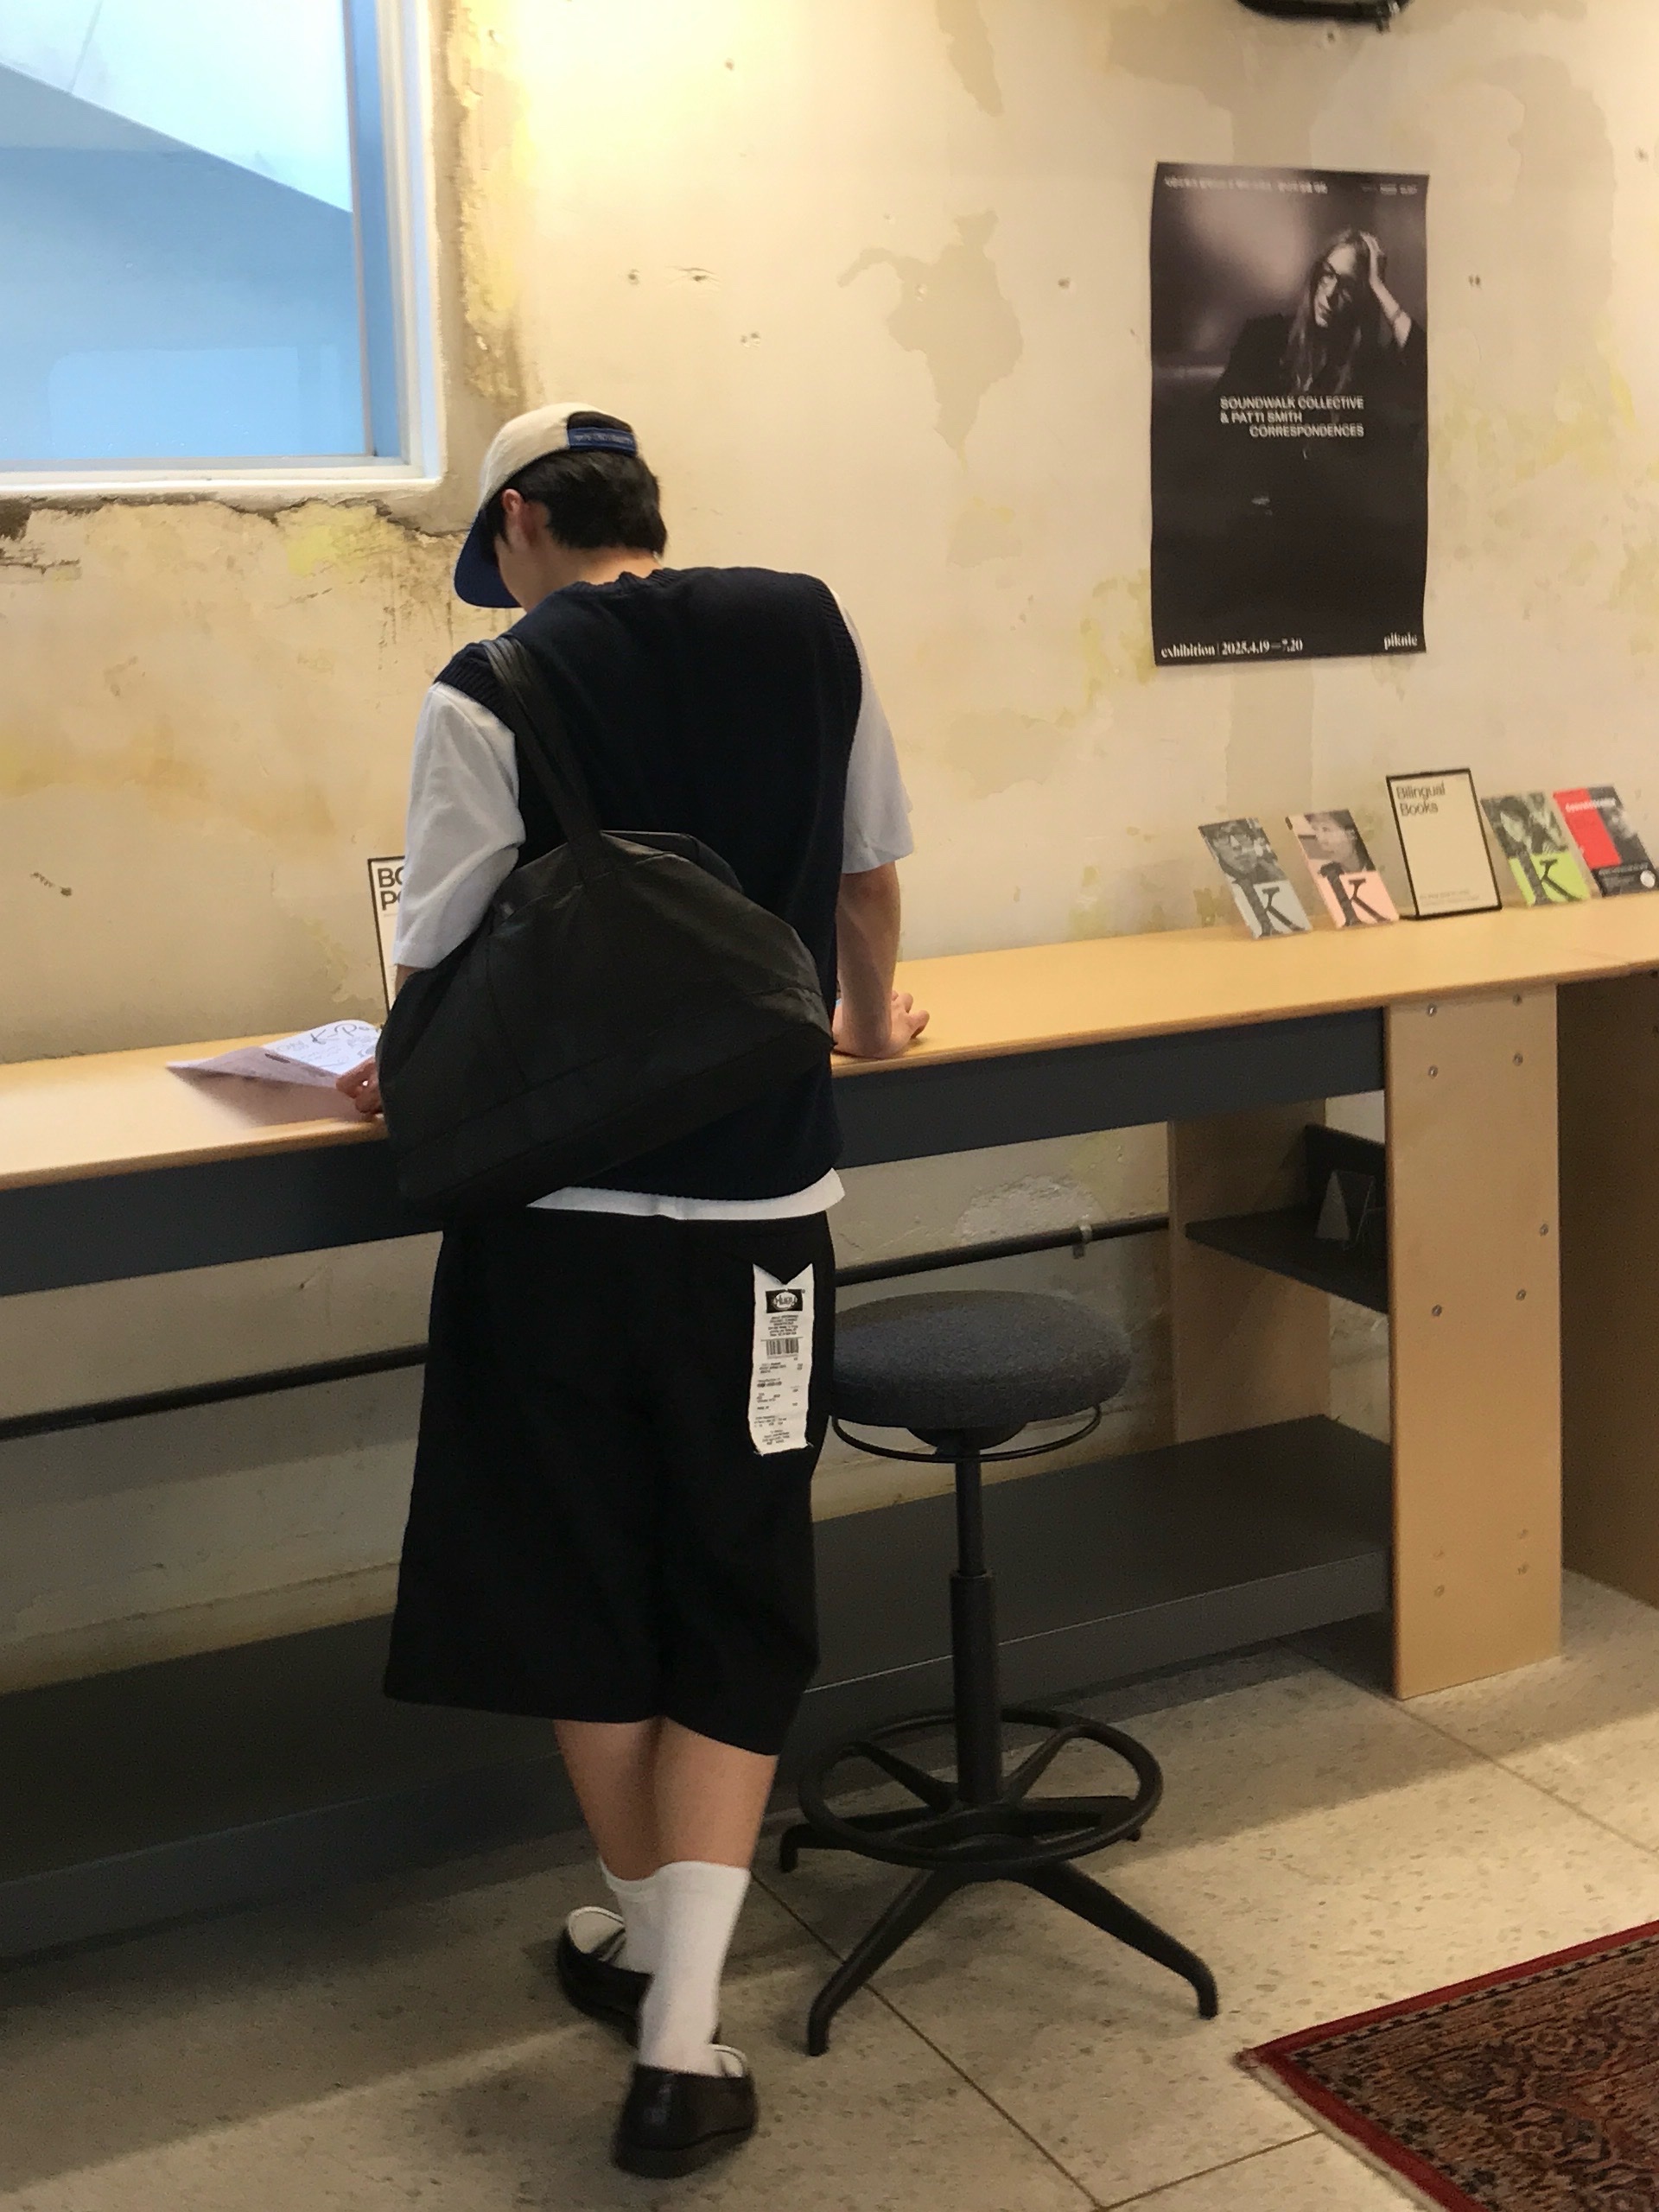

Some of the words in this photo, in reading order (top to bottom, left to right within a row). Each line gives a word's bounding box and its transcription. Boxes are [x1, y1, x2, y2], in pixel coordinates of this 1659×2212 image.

[1220, 395, 1295, 410] SOUNDWALK
[1298, 395, 1364, 410] COLLECTIVE
[1220, 410, 1229, 423] &
[1231, 410, 1265, 423] PATTI
[1268, 410, 1302, 423] SMITH
[1249, 423, 1364, 437] CORRESPONDENCES
[1160, 642, 1215, 658] exhibition
[1396, 781, 1446, 800] Bilingual
[1400, 800, 1439, 816] Books
